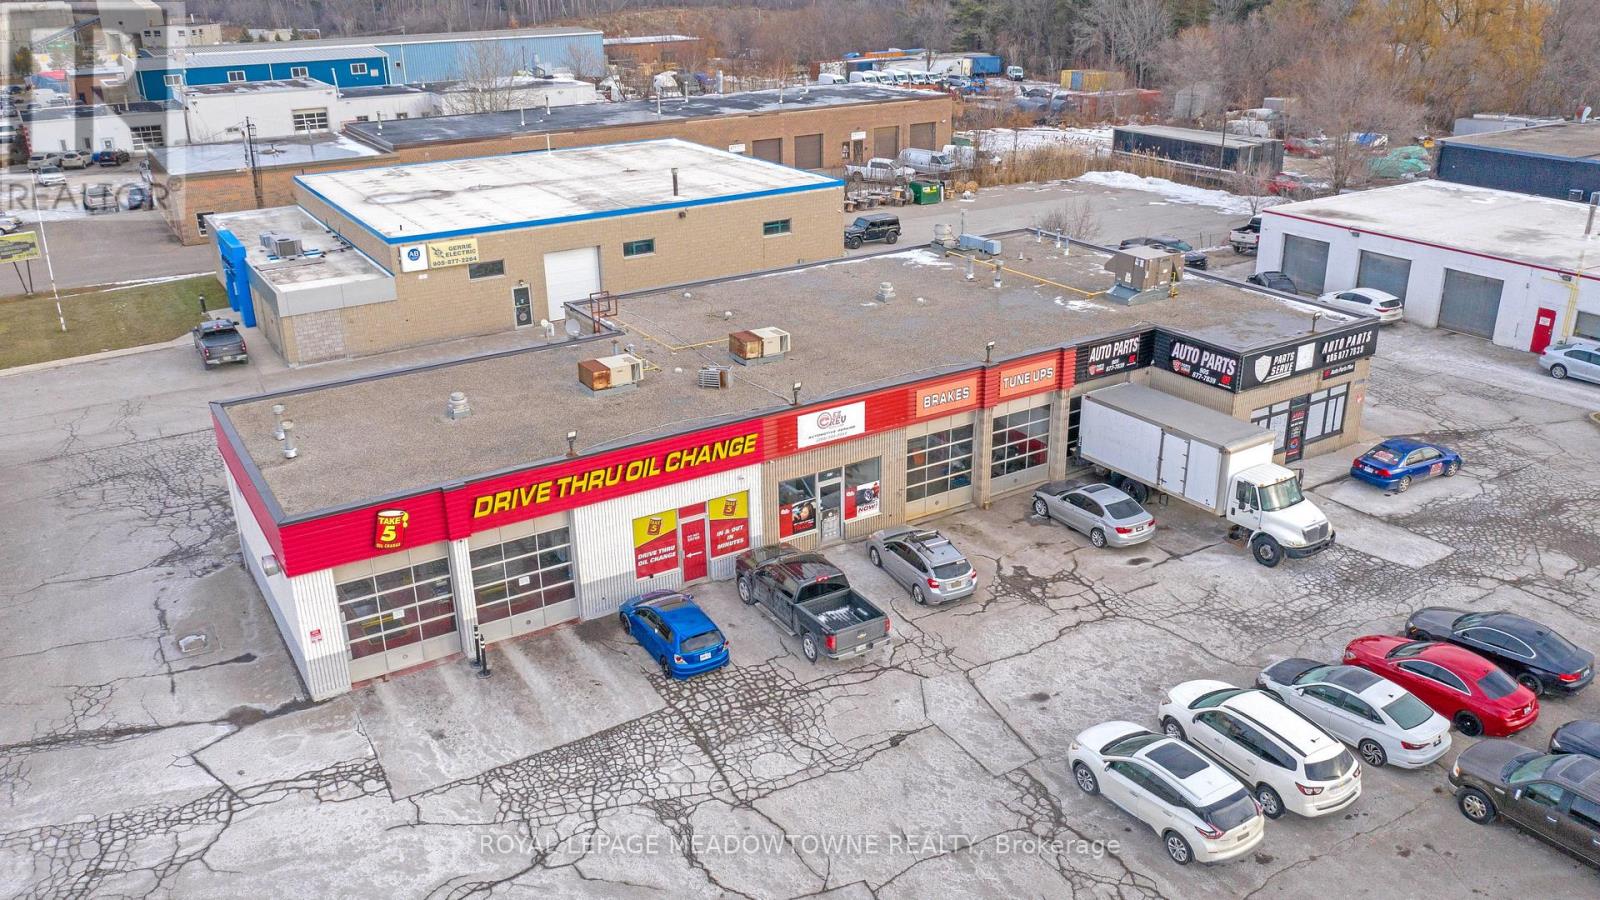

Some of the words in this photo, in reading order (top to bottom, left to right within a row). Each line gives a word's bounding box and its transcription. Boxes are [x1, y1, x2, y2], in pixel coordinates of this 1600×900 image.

[446, 248, 476, 258] ELECTRIC
[1089, 344, 1112, 362] AUTO
[1112, 336, 1140, 356] PARTS
[1322, 338, 1345, 354] AUTO
[1346, 330, 1372, 348] PARTS
[1171, 342, 1200, 364] AUTO
[1200, 351, 1236, 376] PARTS
[1272, 351, 1296, 366] PARTS
[1199, 367, 1209, 376] 905
[1270, 362, 1294, 376] SERVE
[1003, 373, 1030, 389] TUNE
[1032, 367, 1054, 382] UPS
[923, 386, 970, 409] BRAKES
[472, 481, 553, 518] DRIVE
[557, 464, 623, 498] THRU
[625, 456, 661, 482] OIL
[664, 432, 759, 473] CHANGE
[858, 502, 878, 513] NOW!
[378, 516, 401, 525] TAKE
[380, 525, 397, 542] 5
[732, 525, 744, 533] OUT
[717, 538, 744, 550] MINUTES
[638, 550, 657, 560] DRIVE
[659, 545, 676, 554] THRU
[638, 558, 648, 566] OIL
[650, 552, 676, 564] CHANGE
